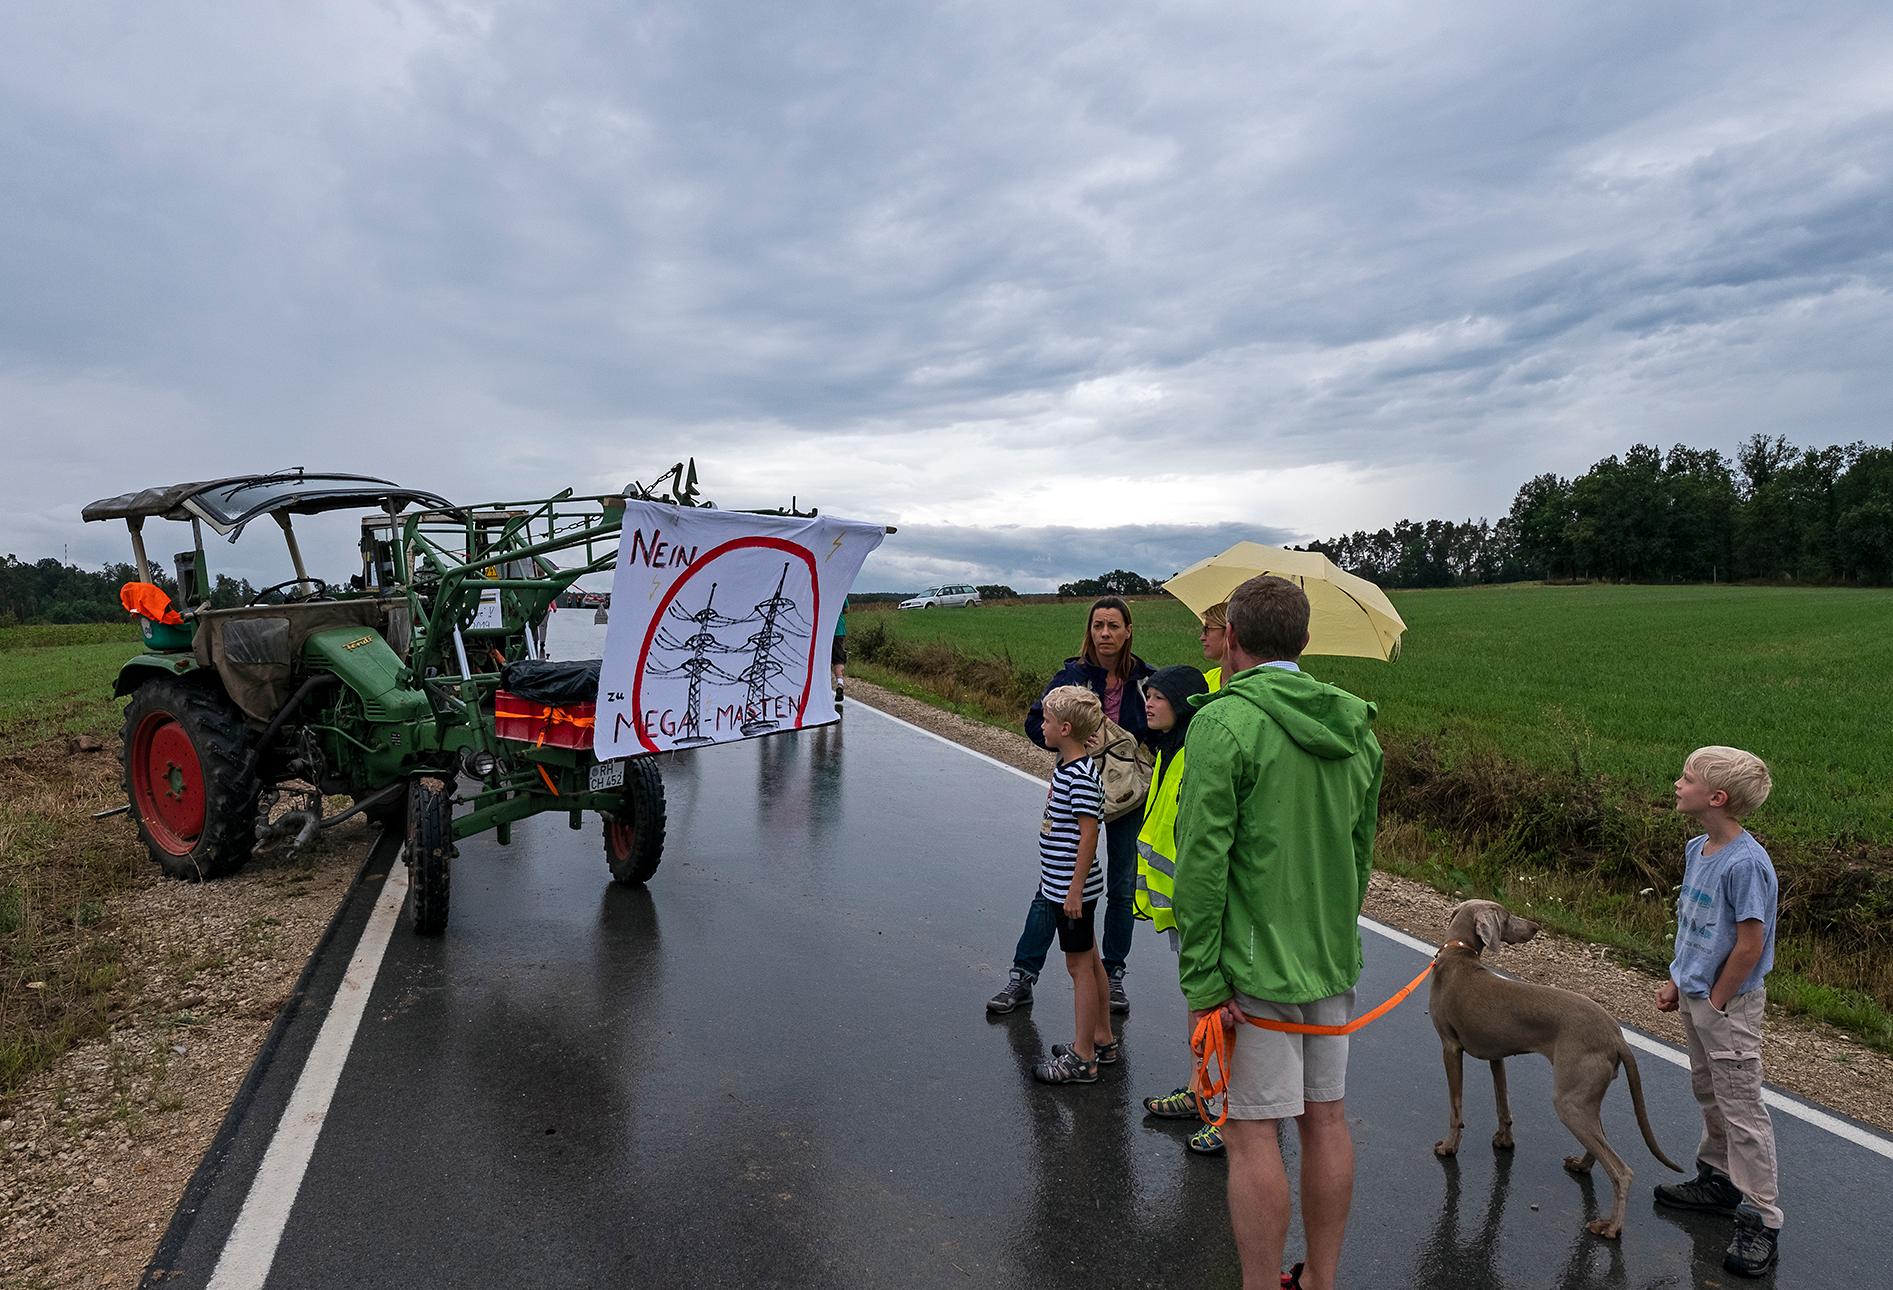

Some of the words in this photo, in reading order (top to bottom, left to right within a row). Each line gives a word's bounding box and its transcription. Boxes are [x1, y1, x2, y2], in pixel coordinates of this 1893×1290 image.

[630, 528, 698, 568] NEIN
[600, 764, 614, 776] RH
[591, 777, 604, 789] CH
[606, 774, 622, 786] 452
